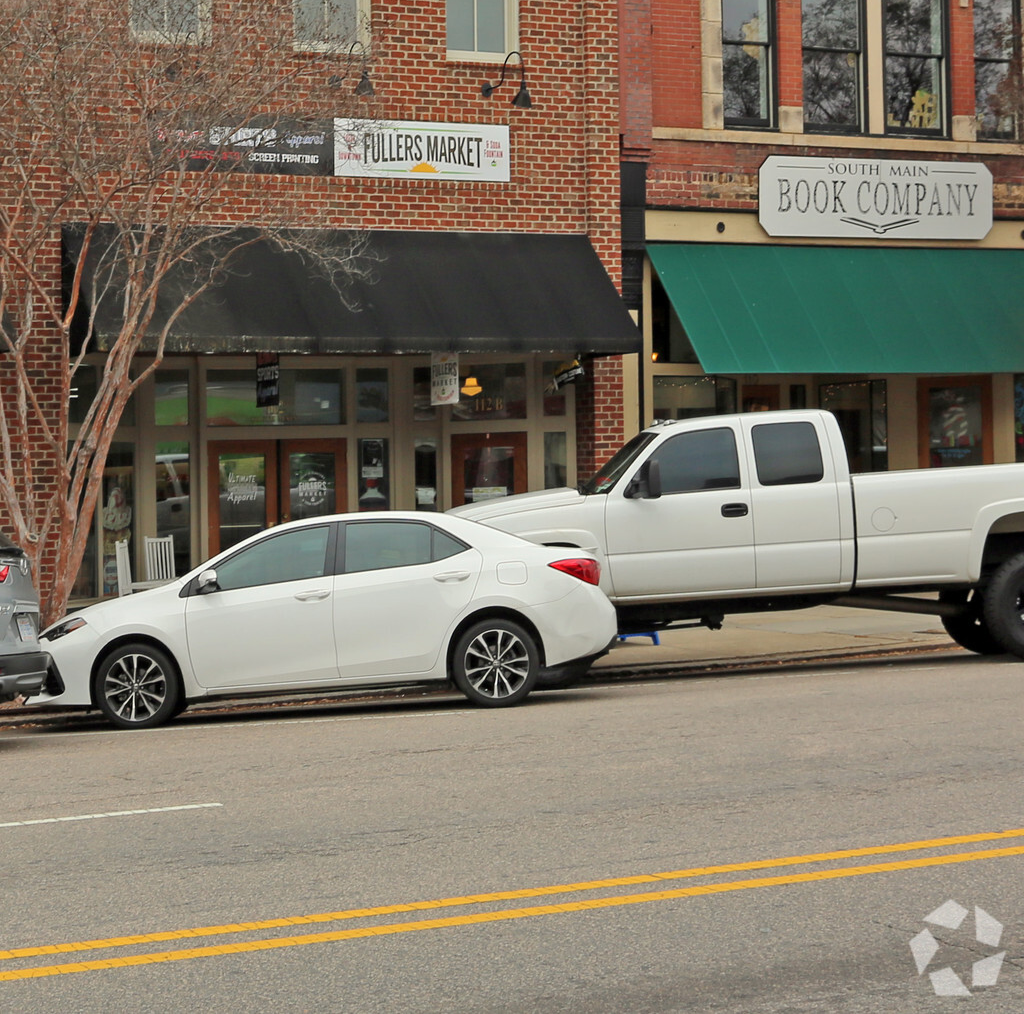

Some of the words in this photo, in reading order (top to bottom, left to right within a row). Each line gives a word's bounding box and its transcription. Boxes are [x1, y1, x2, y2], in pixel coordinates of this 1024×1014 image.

[364, 132, 423, 165] FULLERS
[427, 135, 483, 169] MARKET
[282, 153, 320, 165] PRINTING
[828, 162, 879, 176] SOUTH
[889, 165, 929, 177] MAIN
[777, 178, 847, 214] BOOK
[857, 180, 978, 217] COMPANY
[432, 361, 457, 378] FULLERS
[476, 397, 493, 411] 112
[496, 397, 504, 411] B
[227, 490, 257, 505] Apparel
